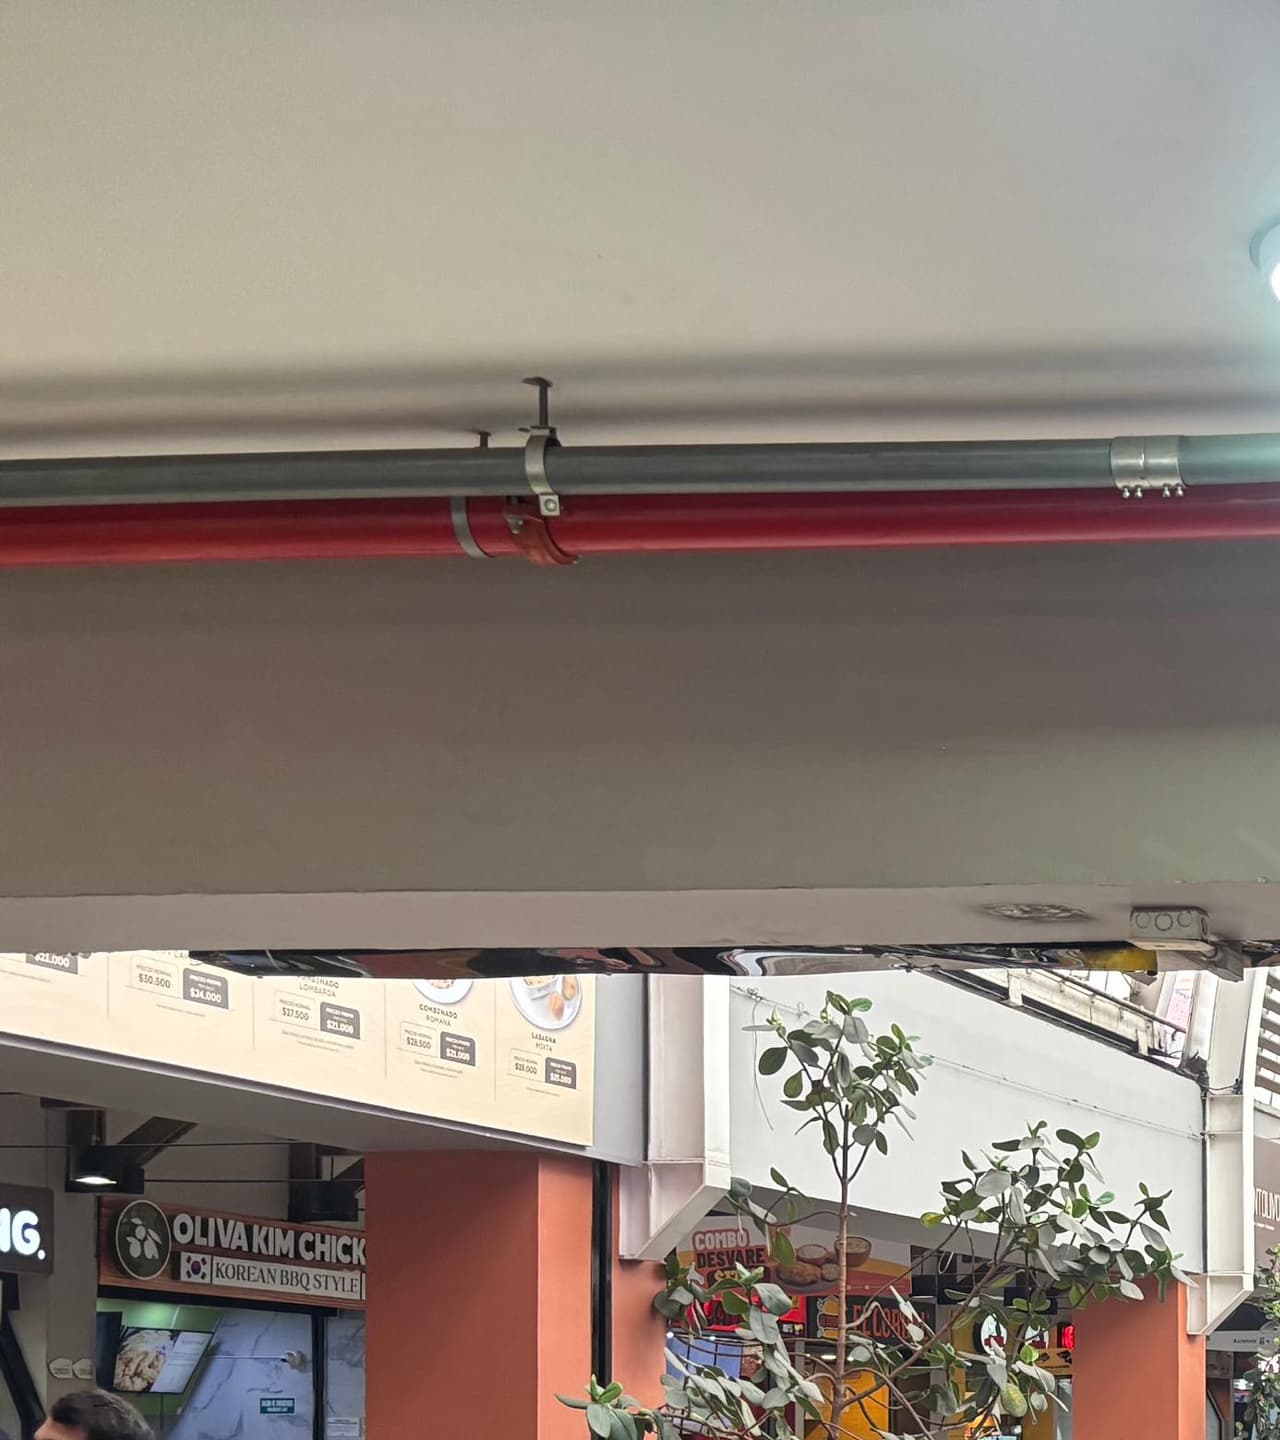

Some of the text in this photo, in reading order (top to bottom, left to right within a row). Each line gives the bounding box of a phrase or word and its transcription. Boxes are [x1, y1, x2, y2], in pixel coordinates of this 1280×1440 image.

[419, 1003, 458, 1020] COMBINADO
[173, 1213, 366, 1265] OLIVA KIM CHICK
[694, 1231, 747, 1250] COMBO
[696, 1248, 765, 1268] DESVARE
[215, 1261, 359, 1295] KOREAN BBQ STYLE
